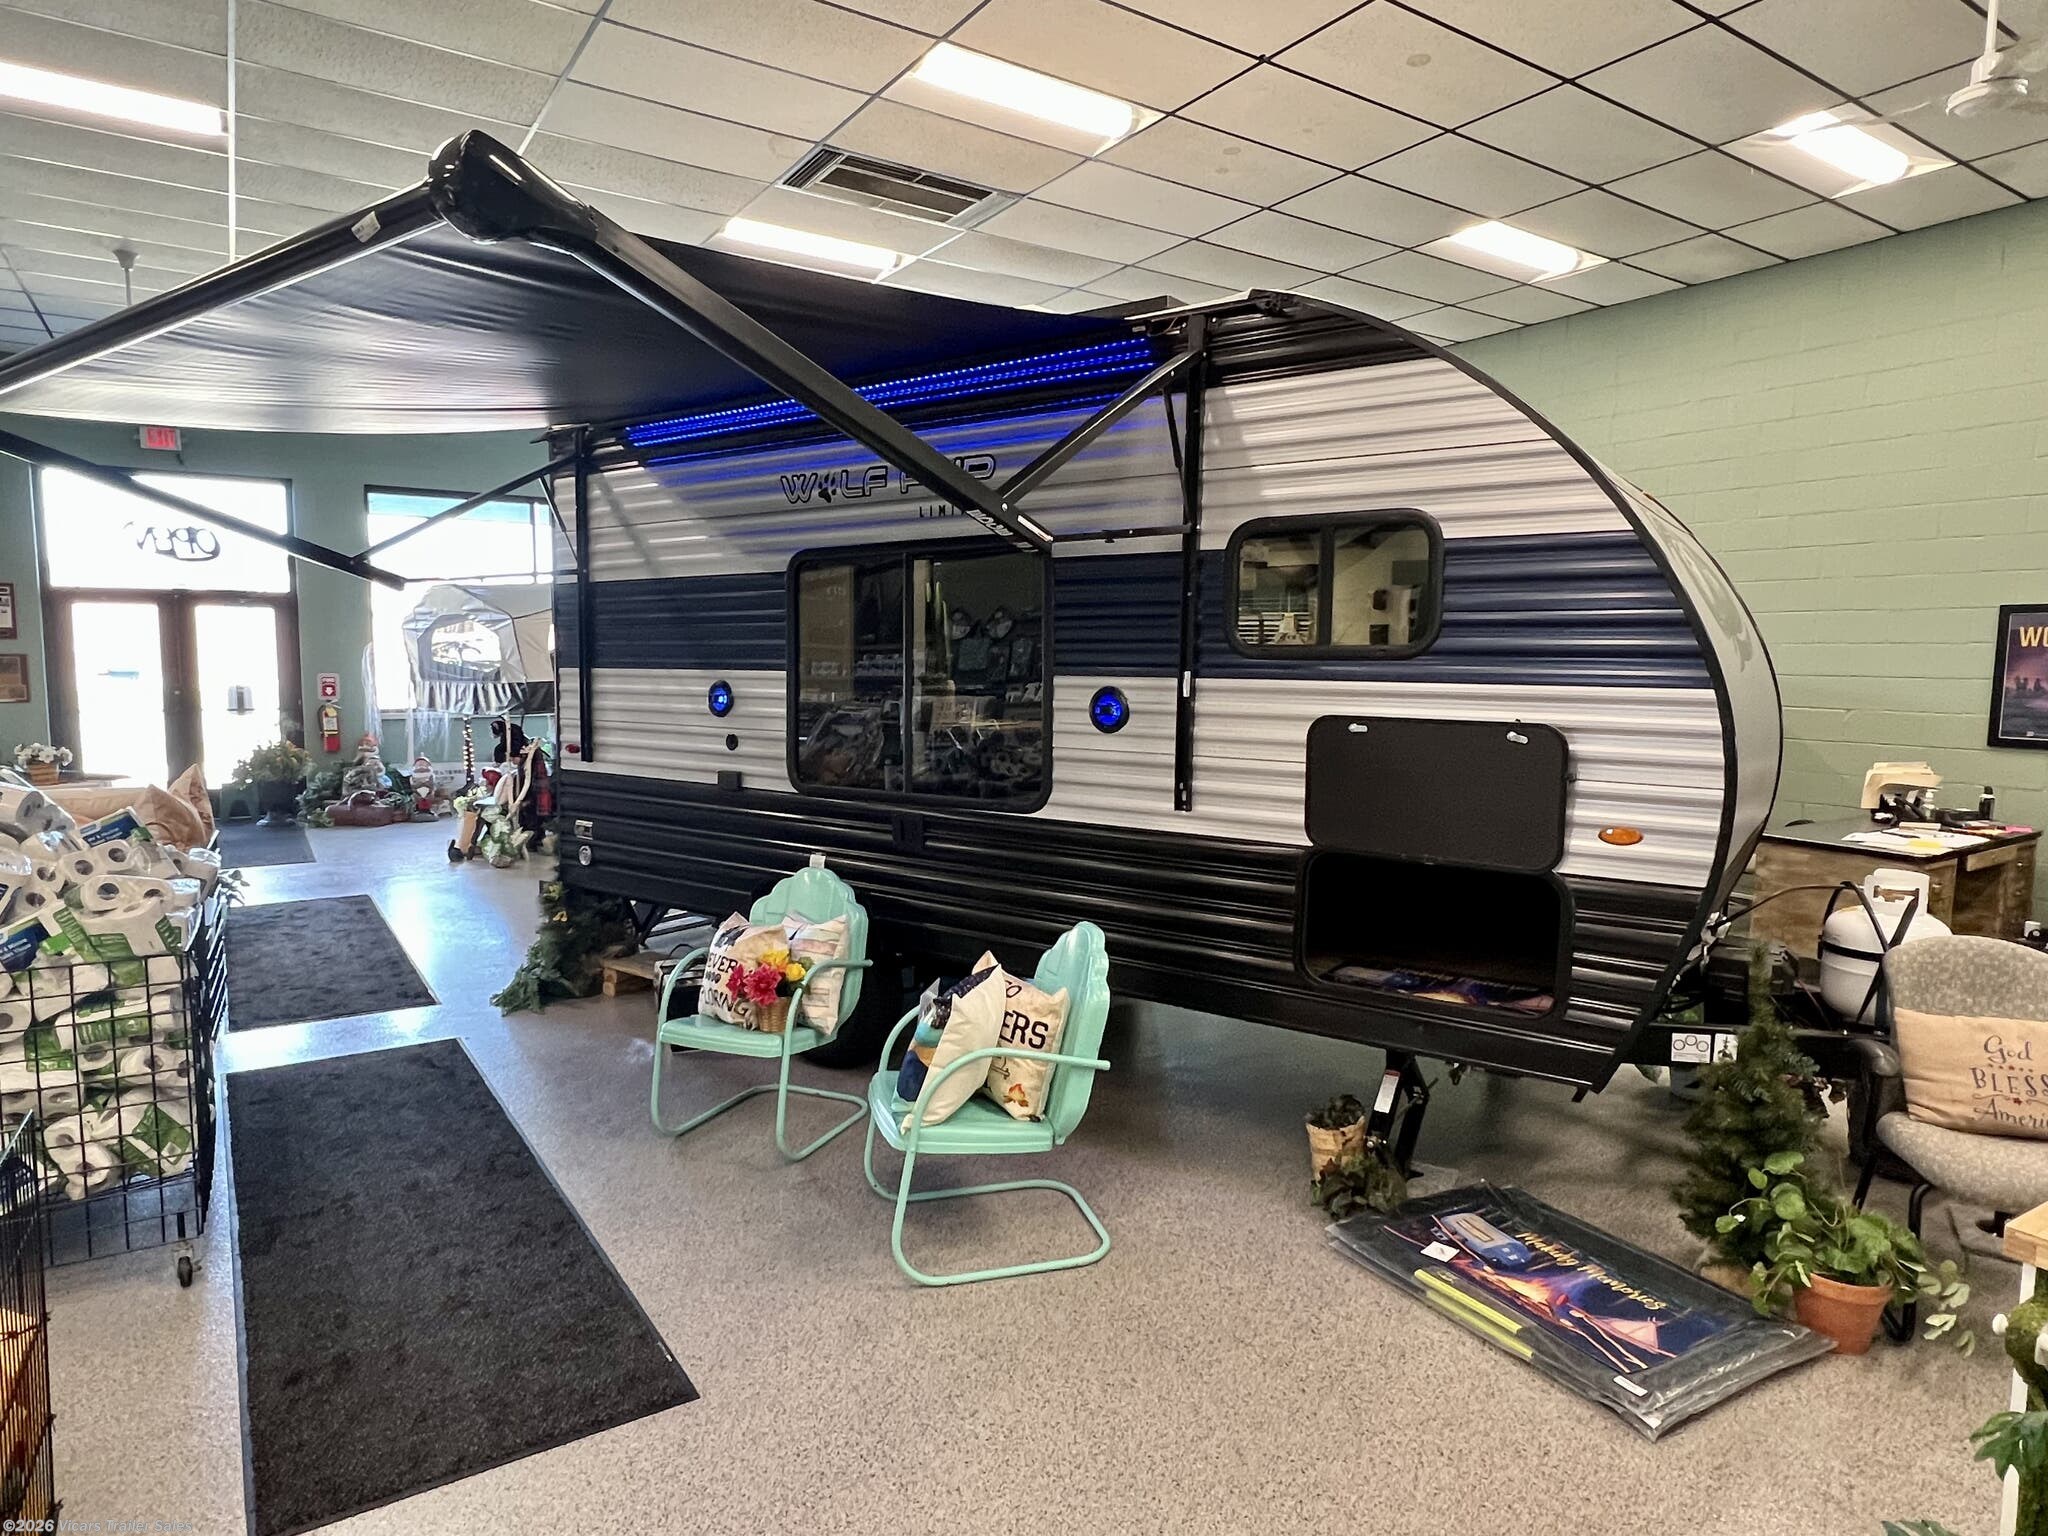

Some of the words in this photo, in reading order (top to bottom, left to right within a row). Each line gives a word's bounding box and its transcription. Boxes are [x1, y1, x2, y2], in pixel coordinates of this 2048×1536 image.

[1983, 1034, 2034, 1064] God
[1973, 1097, 2048, 1129] Ameri
[1576, 1263, 1668, 1311] Memories
